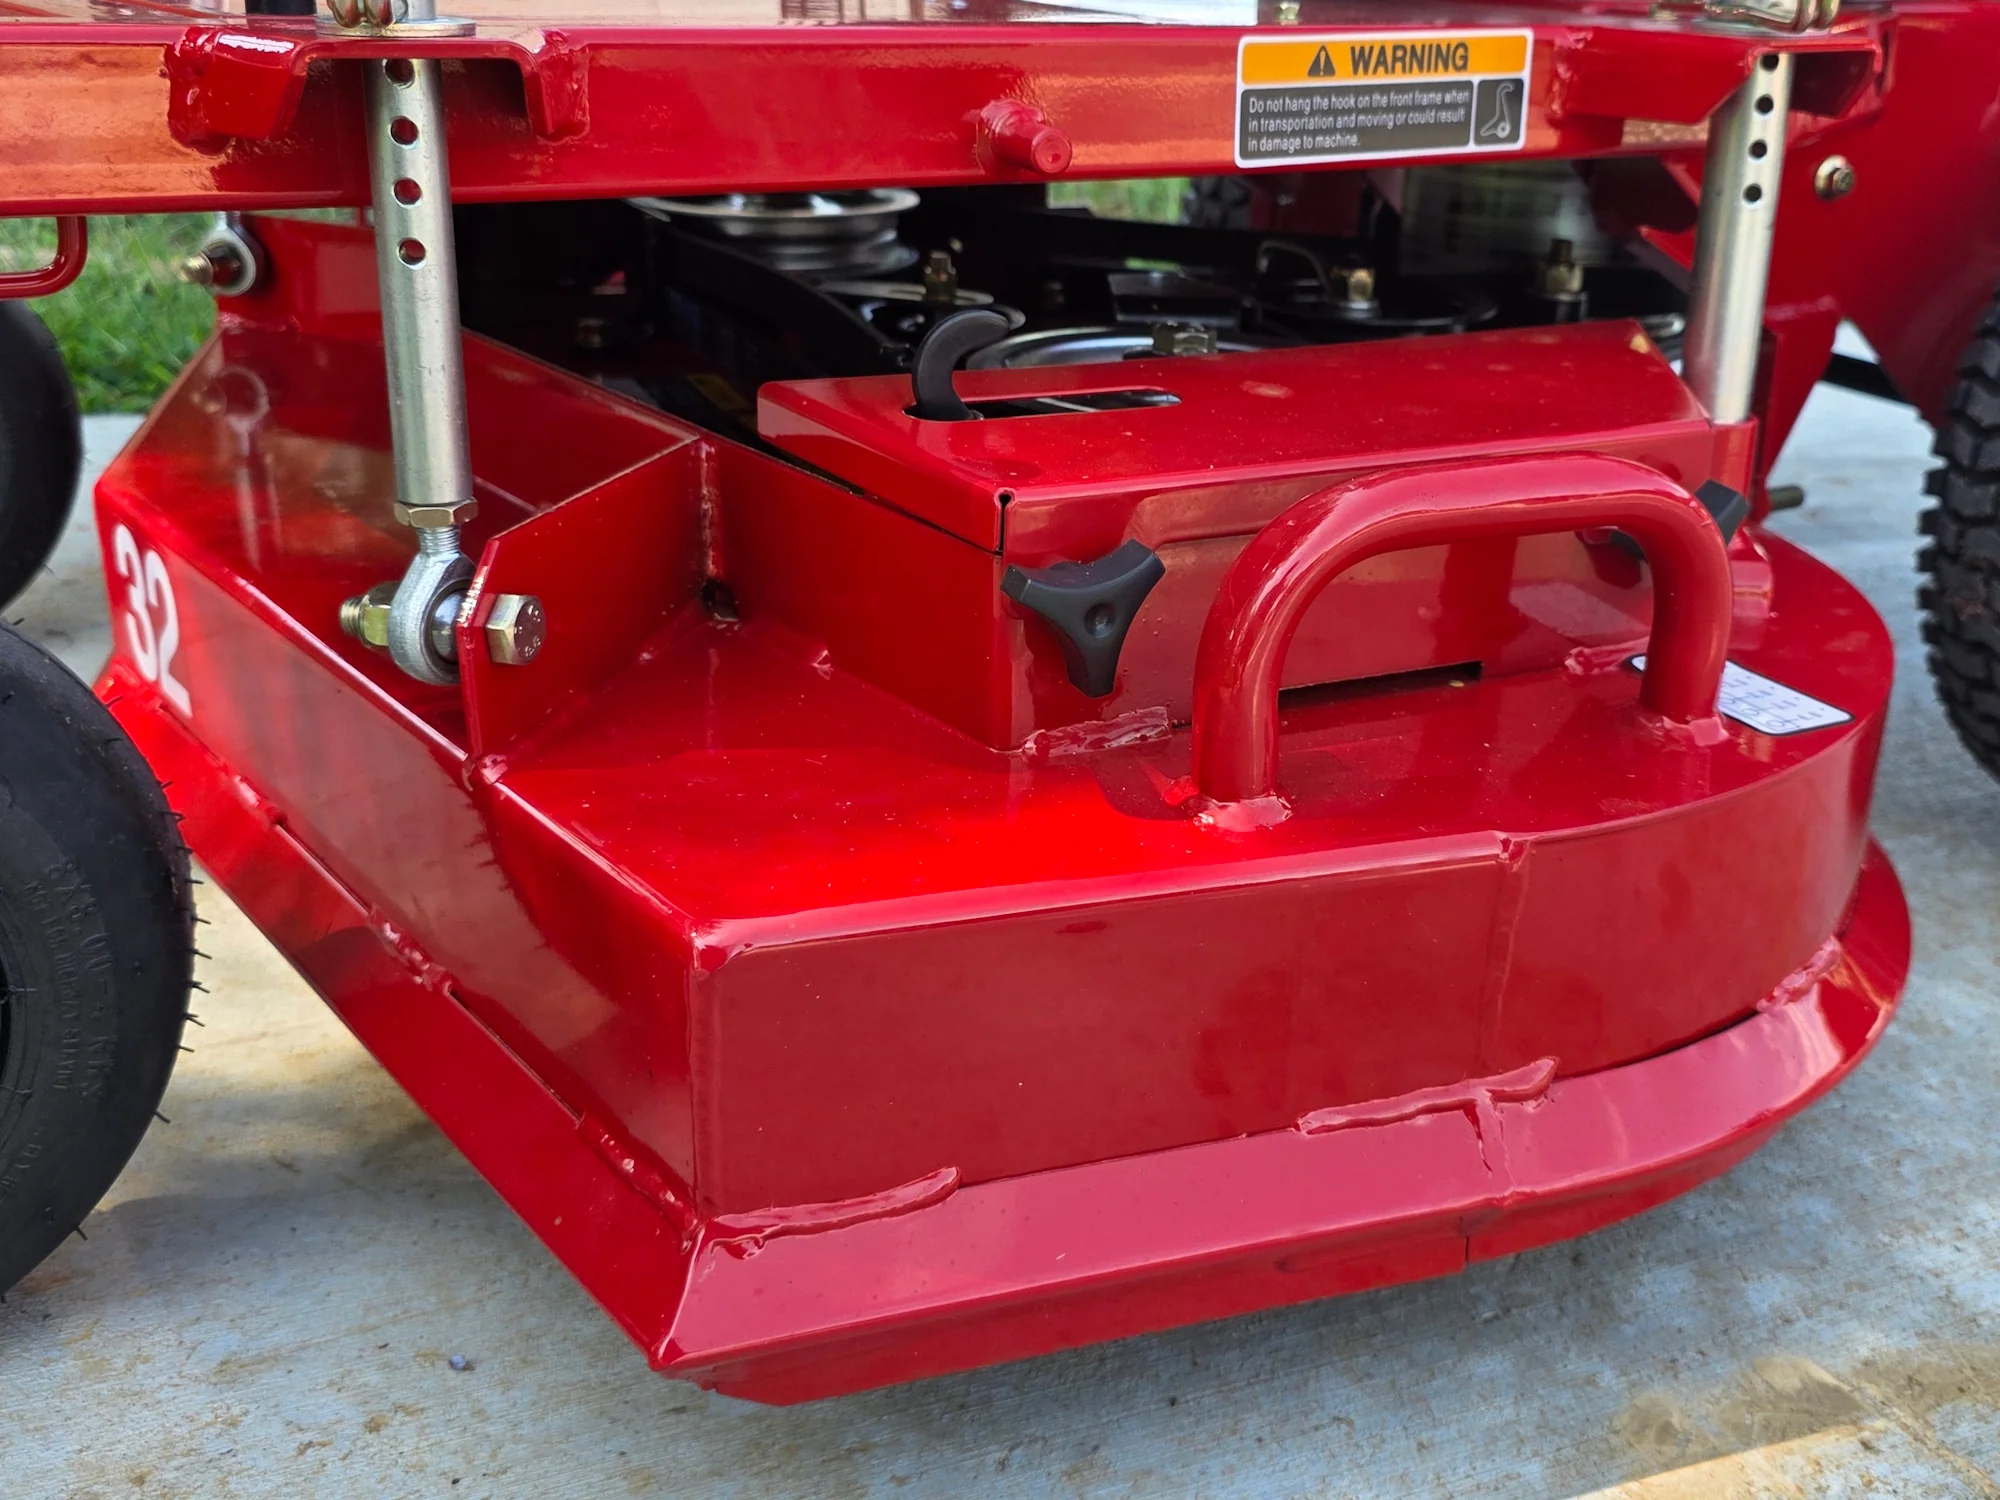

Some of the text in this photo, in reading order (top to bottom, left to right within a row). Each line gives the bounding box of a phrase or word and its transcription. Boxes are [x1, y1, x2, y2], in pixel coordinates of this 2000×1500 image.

[1350, 42, 1470, 76] WARNING
[1249, 88, 1469, 115] Do not hang the hook on the front frame when
[1248, 106, 1466, 135] in transportation and moving or could result
[1247, 132, 1360, 154] in damage to machine.
[115, 523, 193, 718] 32
